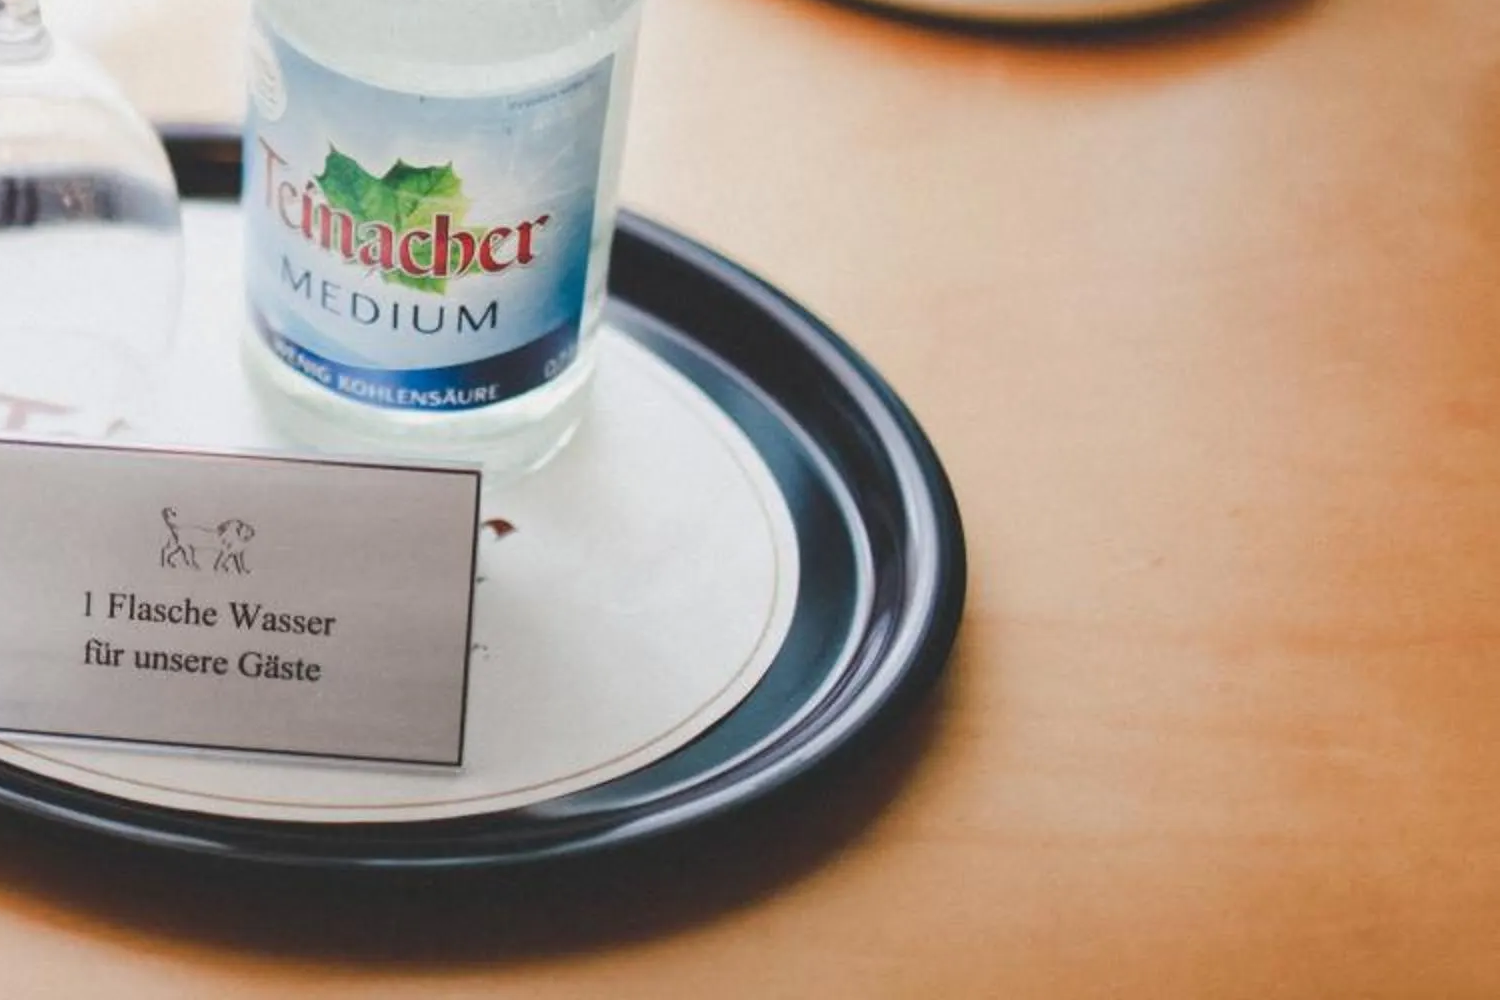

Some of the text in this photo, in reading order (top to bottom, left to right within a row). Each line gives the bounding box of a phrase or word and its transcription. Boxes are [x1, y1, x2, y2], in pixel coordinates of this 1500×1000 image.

[258, 137, 550, 278] Teinacher
[280, 254, 499, 334] MEDIUM
[339, 374, 499, 406] KOHLENSÄURE
[107, 592, 218, 627] Flasche
[229, 601, 336, 636] Wasser
[84, 638, 321, 681] für unsere Gäste
